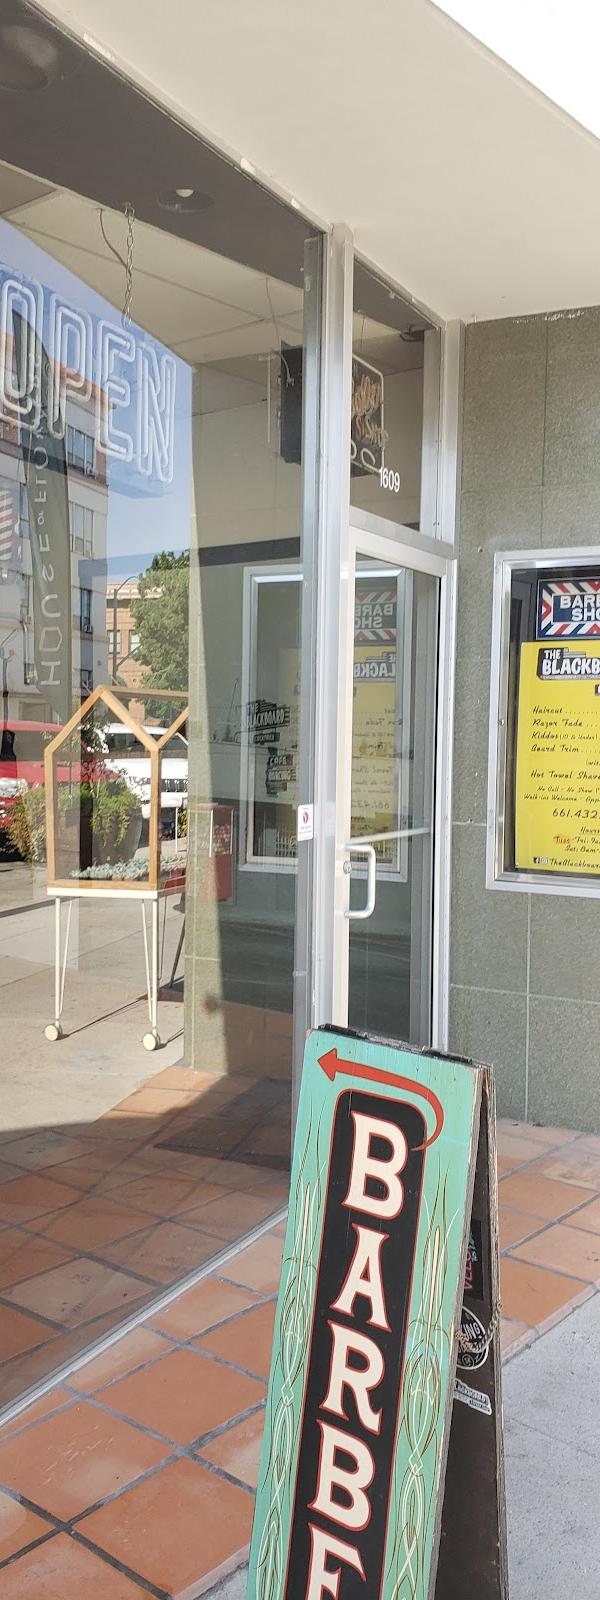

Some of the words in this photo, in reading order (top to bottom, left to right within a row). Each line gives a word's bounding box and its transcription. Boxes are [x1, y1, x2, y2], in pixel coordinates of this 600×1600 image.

[0, 278, 177, 485] OPEN
[379, 467, 400, 493] 1609
[544, 649, 561, 660] THE
[542, 657, 600, 676] BLACKB
[533, 705, 563, 715] Haircut
[531, 718, 558, 730] Razor
[562, 718, 583, 727] Fade
[530, 744, 556, 753] Beard
[560, 744, 579, 753] Trim
[530, 769, 544, 779] Hot
[548, 770, 573, 780] Towel
